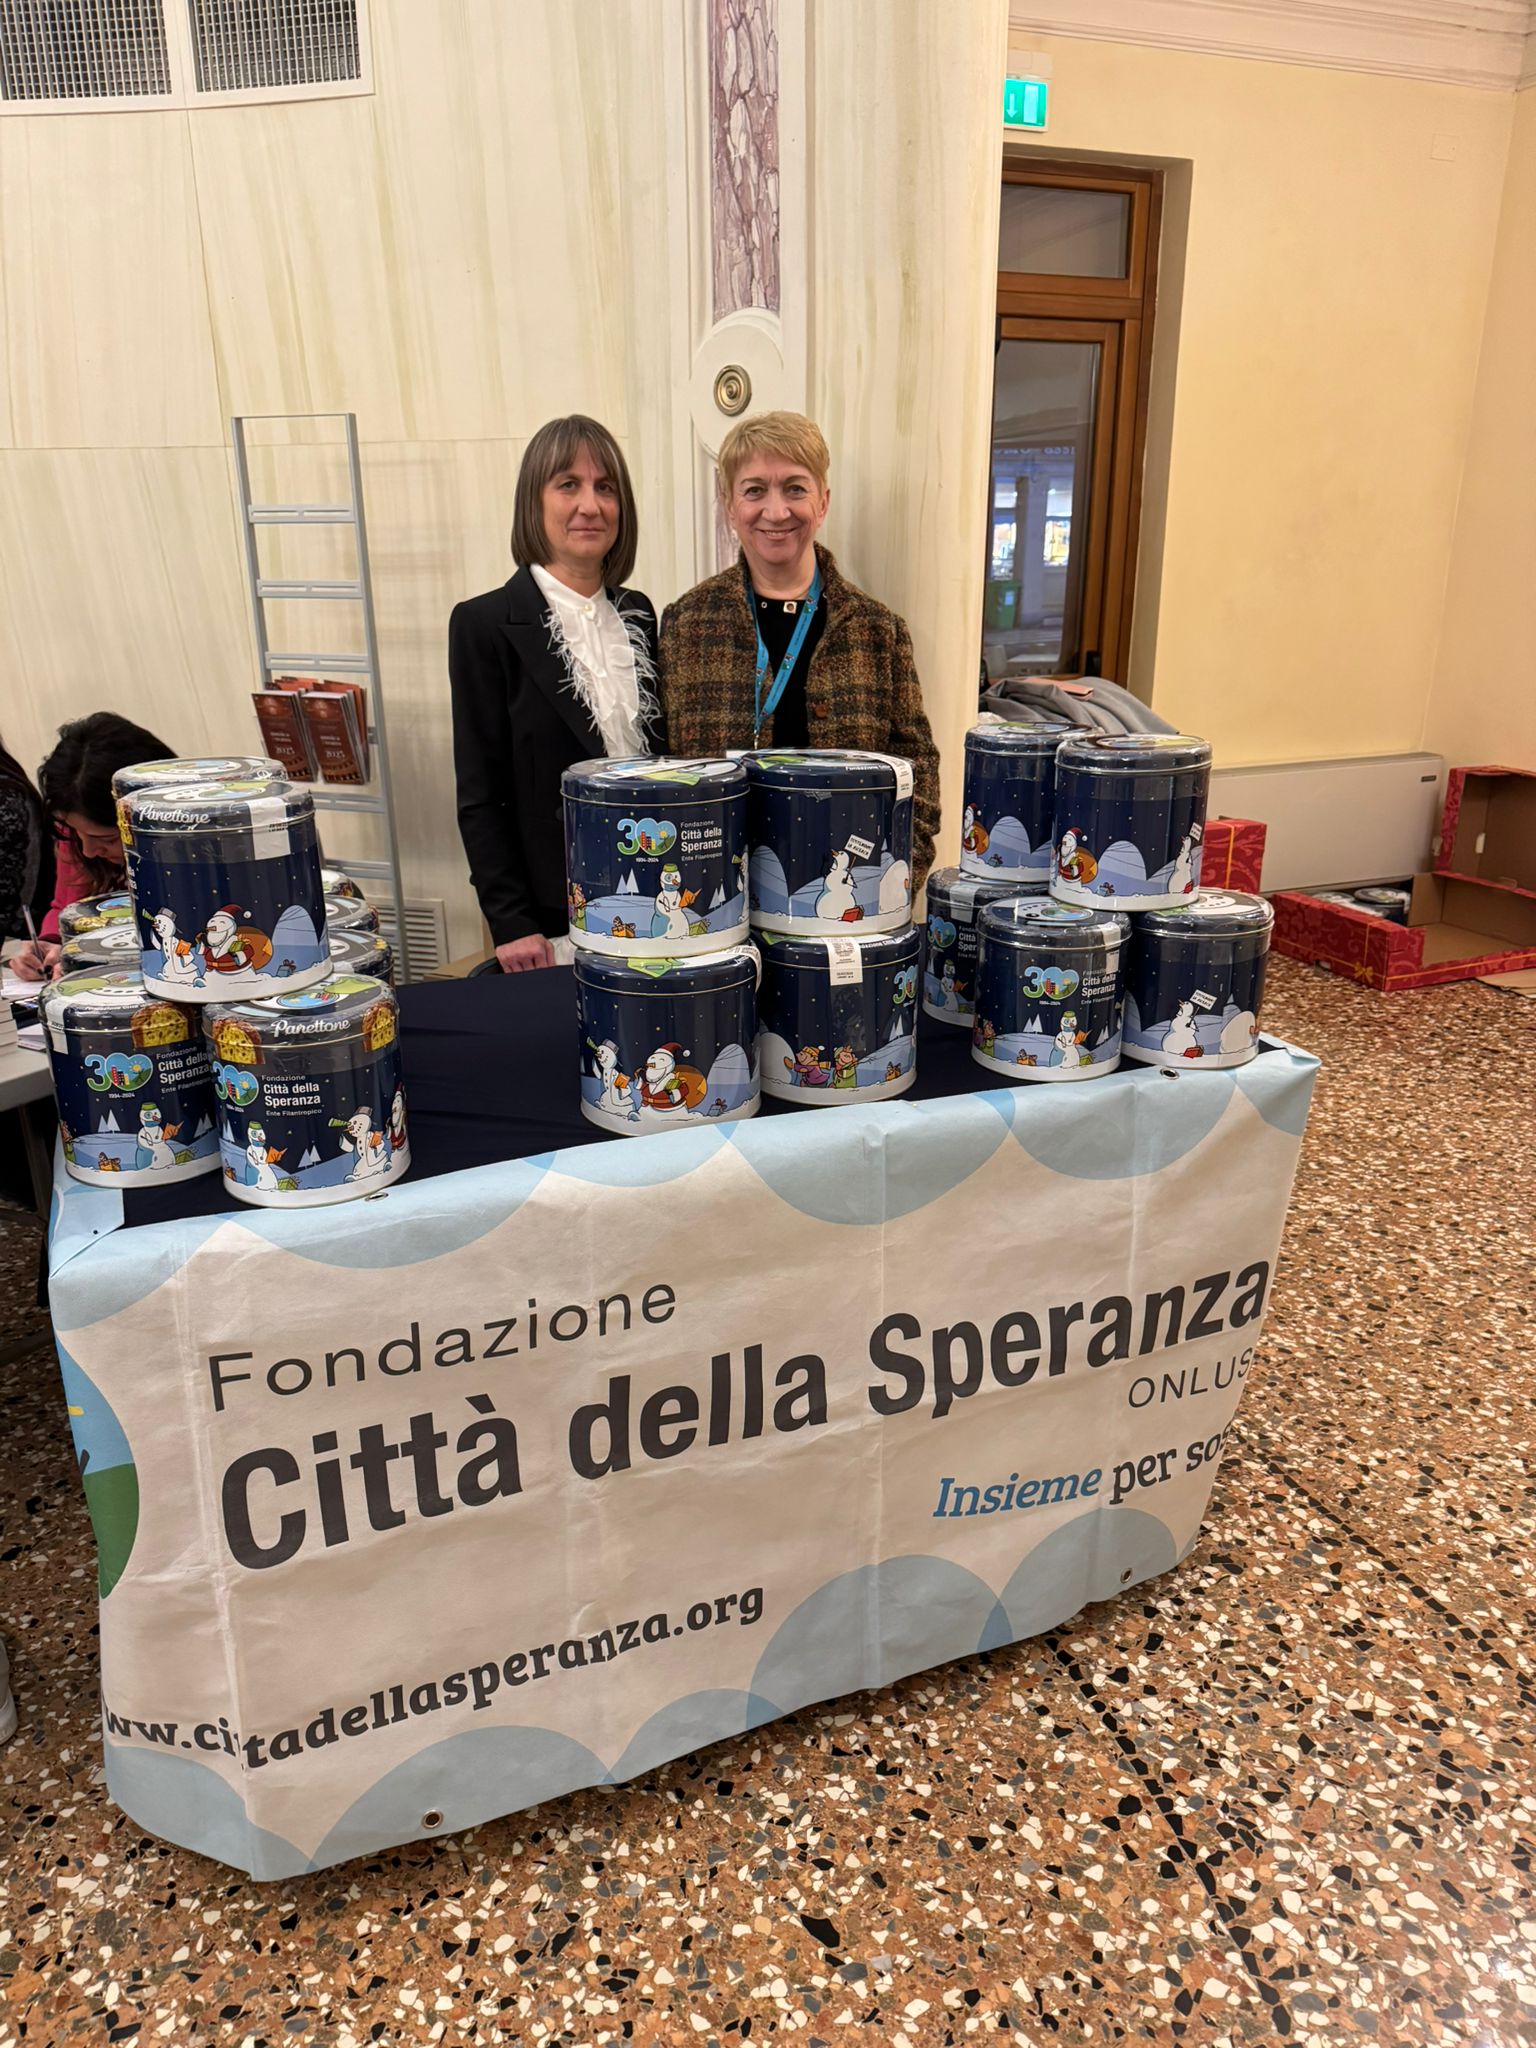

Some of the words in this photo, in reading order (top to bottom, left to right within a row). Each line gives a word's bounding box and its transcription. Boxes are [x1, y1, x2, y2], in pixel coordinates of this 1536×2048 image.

[139, 805, 211, 824] Panettone
[681, 820, 715, 828] Fondazione
[681, 829, 701, 841] Città
[704, 827, 722, 838] della
[681, 839, 722, 853] Speranza
[958, 932, 976, 942] Città
[958, 941, 977, 951] Sper
[1082, 976, 1100, 987] Città
[1081, 983, 1116, 997] Speranza
[271, 1019, 351, 1037] Panettone
[156, 1046, 197, 1060] Fondazione
[158, 1058, 183, 1072] Città
[186, 1053, 208, 1066] della
[159, 1063, 210, 1084] Speranza
[262, 1074, 306, 1082] Fondazione
[161, 1086, 176, 1094] Ente
[263, 1083, 289, 1095] Città
[292, 1082, 320, 1094] della
[265, 1094, 321, 1108] Speranza
[282, 1108, 322, 1117] Filantropico
[207, 1283, 678, 1412] Fondazione
[1128, 1347, 1253, 1408] ONLUS
[221, 1392, 524, 1570] Città
[568, 1343, 828, 1480] della
[867, 1260, 1270, 1419] Speranza
[933, 1467, 1102, 1519] Insieme
[1109, 1448, 1177, 1505] per
